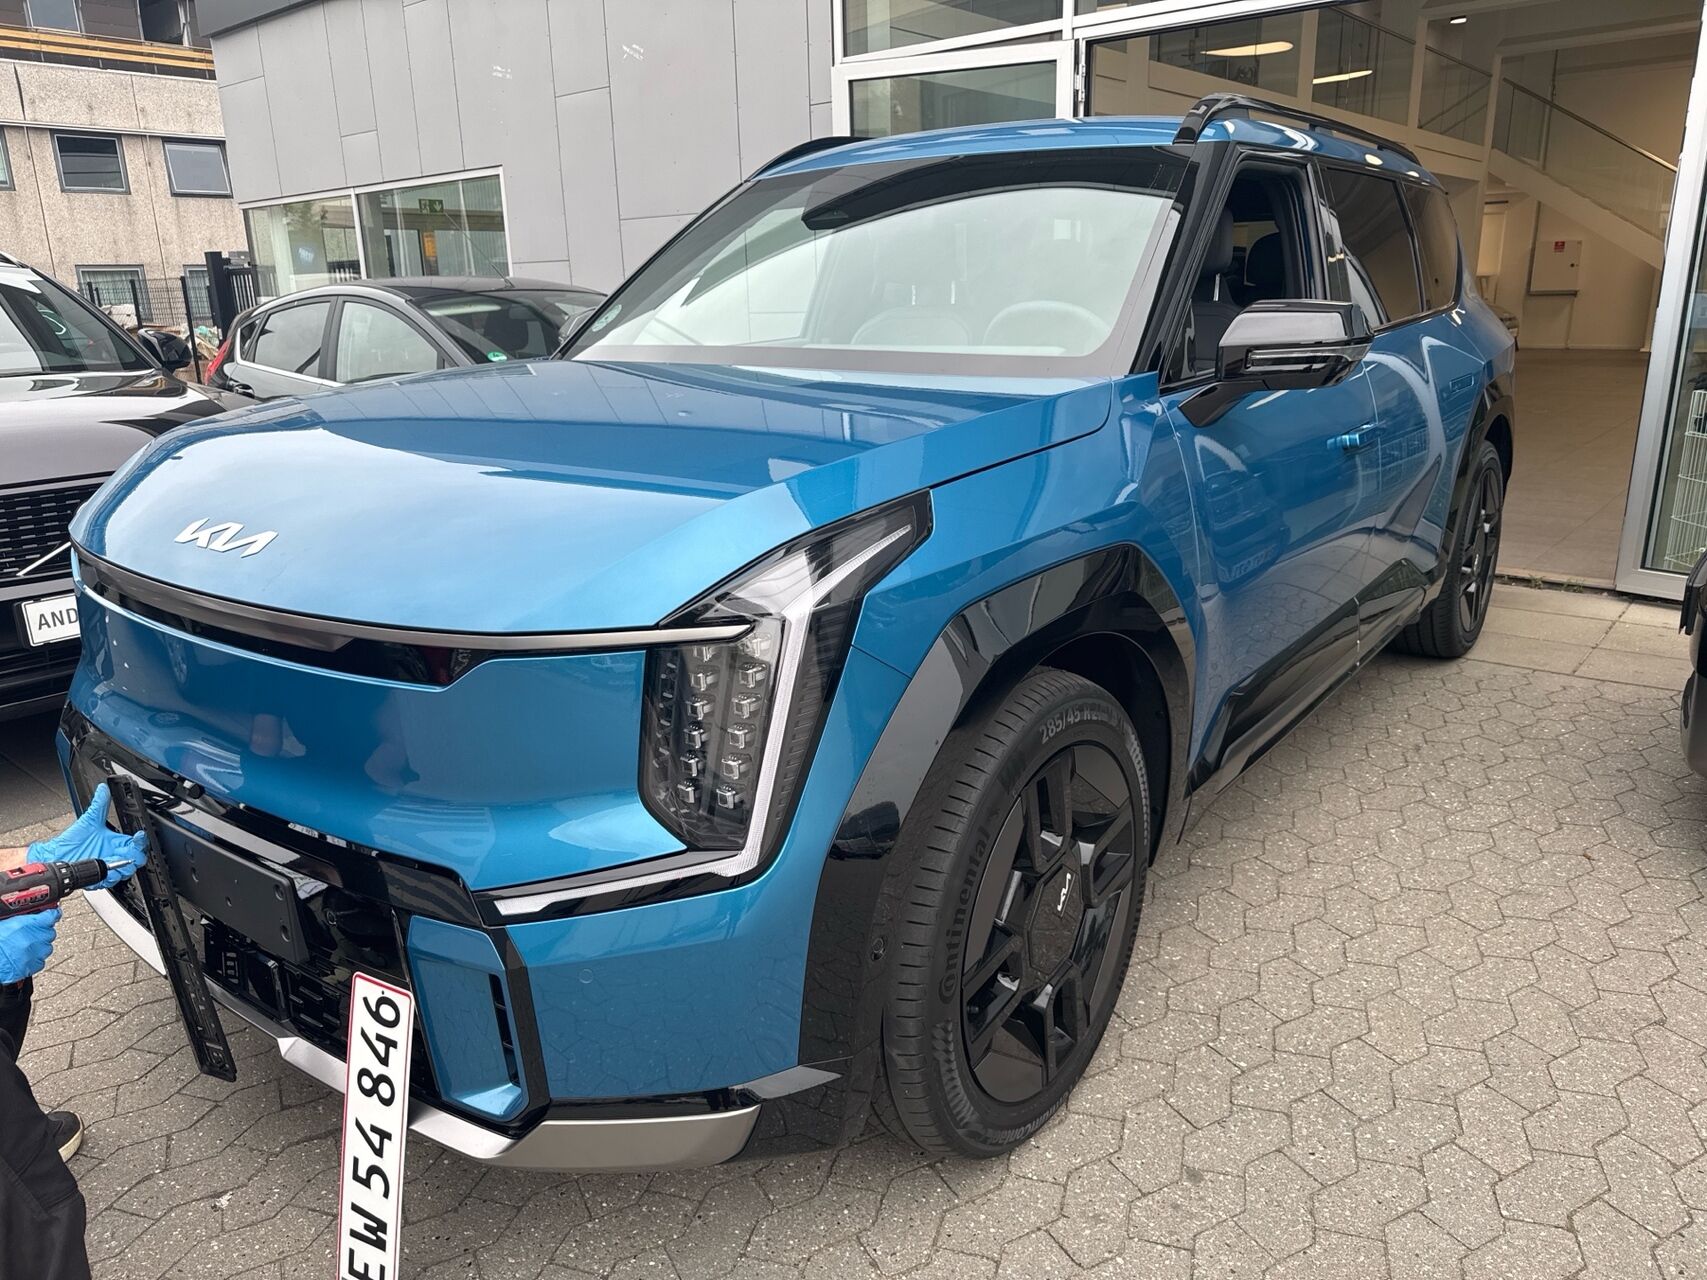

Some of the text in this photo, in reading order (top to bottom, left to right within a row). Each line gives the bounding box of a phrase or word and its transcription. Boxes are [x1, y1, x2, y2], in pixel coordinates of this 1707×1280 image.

[174, 517, 279, 559] KIA
[1039, 706, 1081, 745] 285/45
[938, 825, 991, 1004] Continental
[357, 995, 401, 1108] 846
[352, 1116, 393, 1200] 54
